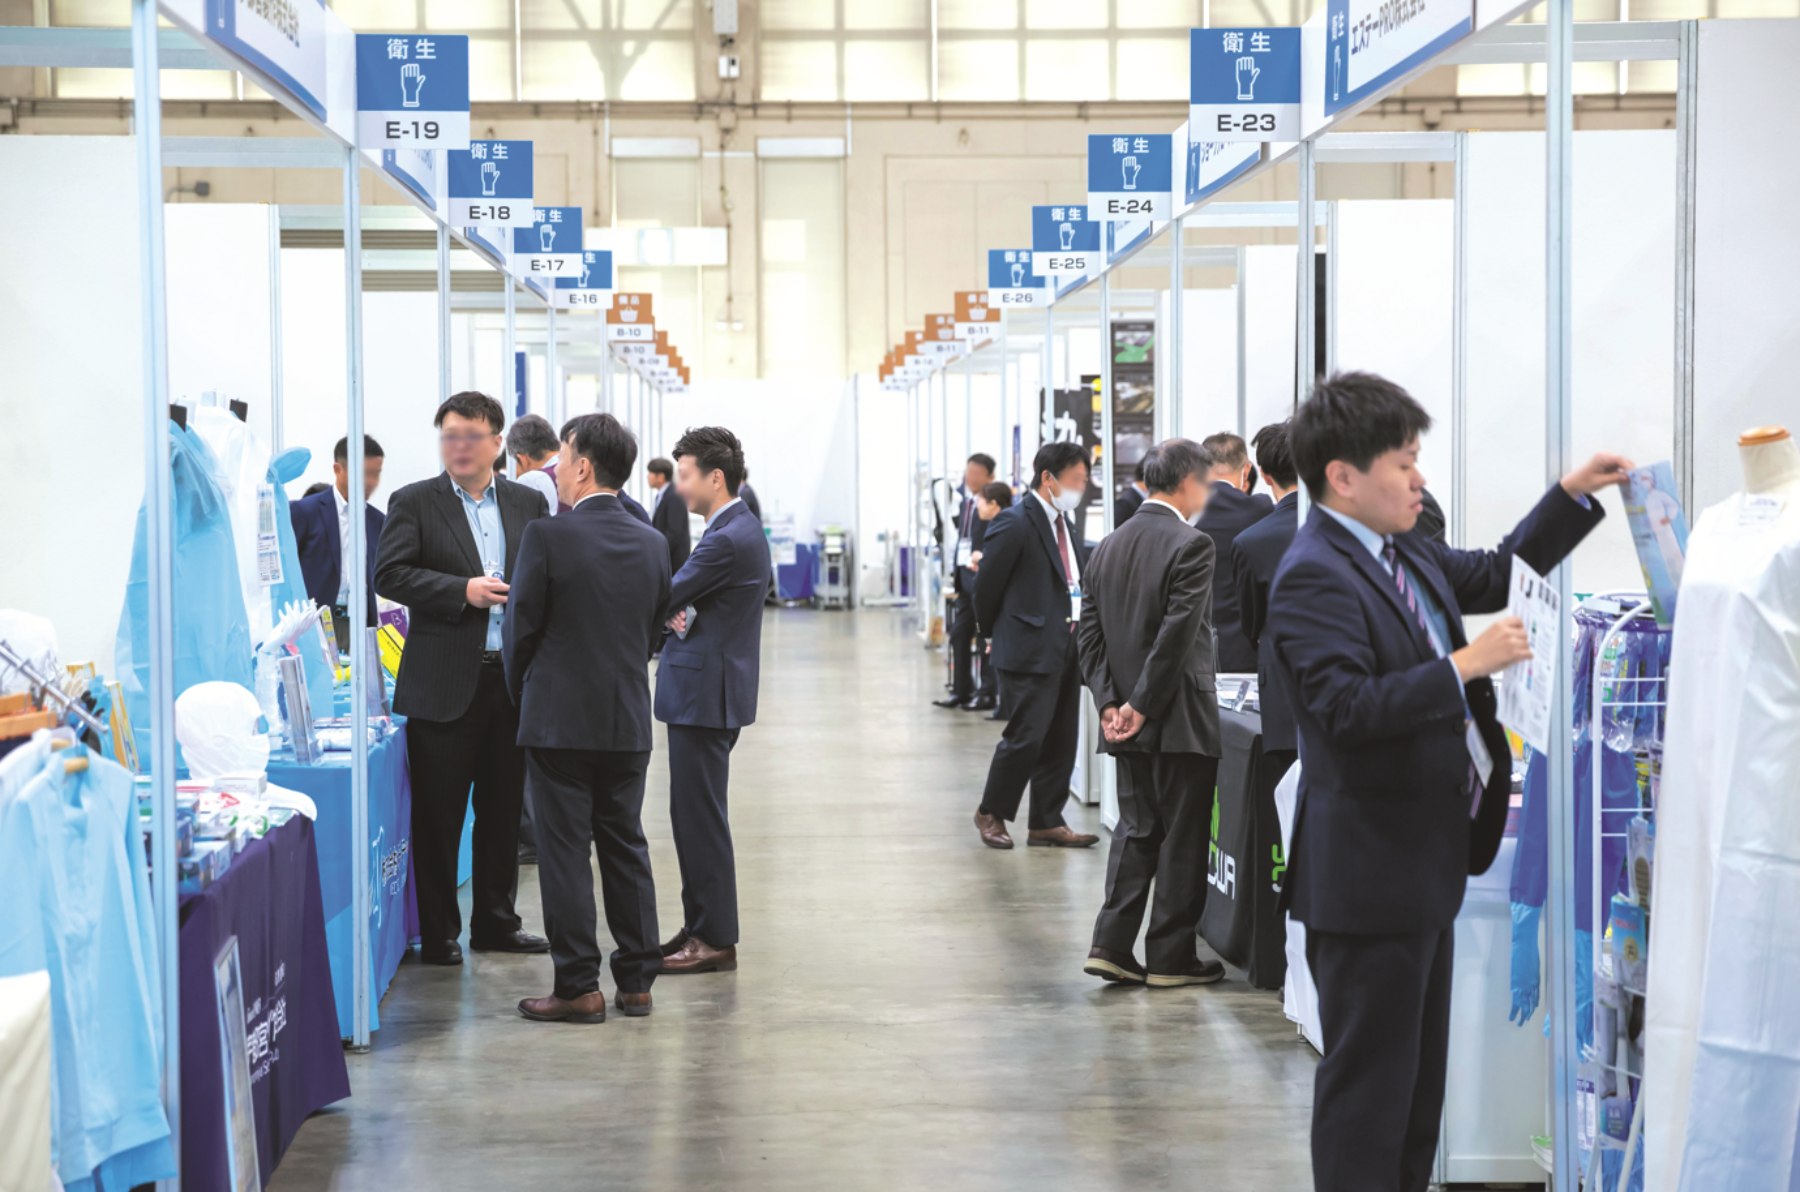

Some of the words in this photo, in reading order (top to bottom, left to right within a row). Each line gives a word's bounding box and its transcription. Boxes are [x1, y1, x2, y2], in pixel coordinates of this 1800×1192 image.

[387, 38, 437, 60] 衛生
[1222, 31, 1271, 53] 衛生
[386, 121, 439, 139] E-19
[1217, 114, 1276, 132] E-23
[471, 143, 508, 160] 衛生
[1112, 137, 1150, 154] 衛生
[469, 205, 511, 220] E-18
[1108, 199, 1153, 214] E-24
[1051, 208, 1081, 221] 衛生
[531, 260, 564, 271] E-17
[1049, 258, 1085, 270] E-25
[569, 294, 597, 304] E-16
[1002, 293, 1033, 303] E-26
[617, 328, 641, 336] B-10
